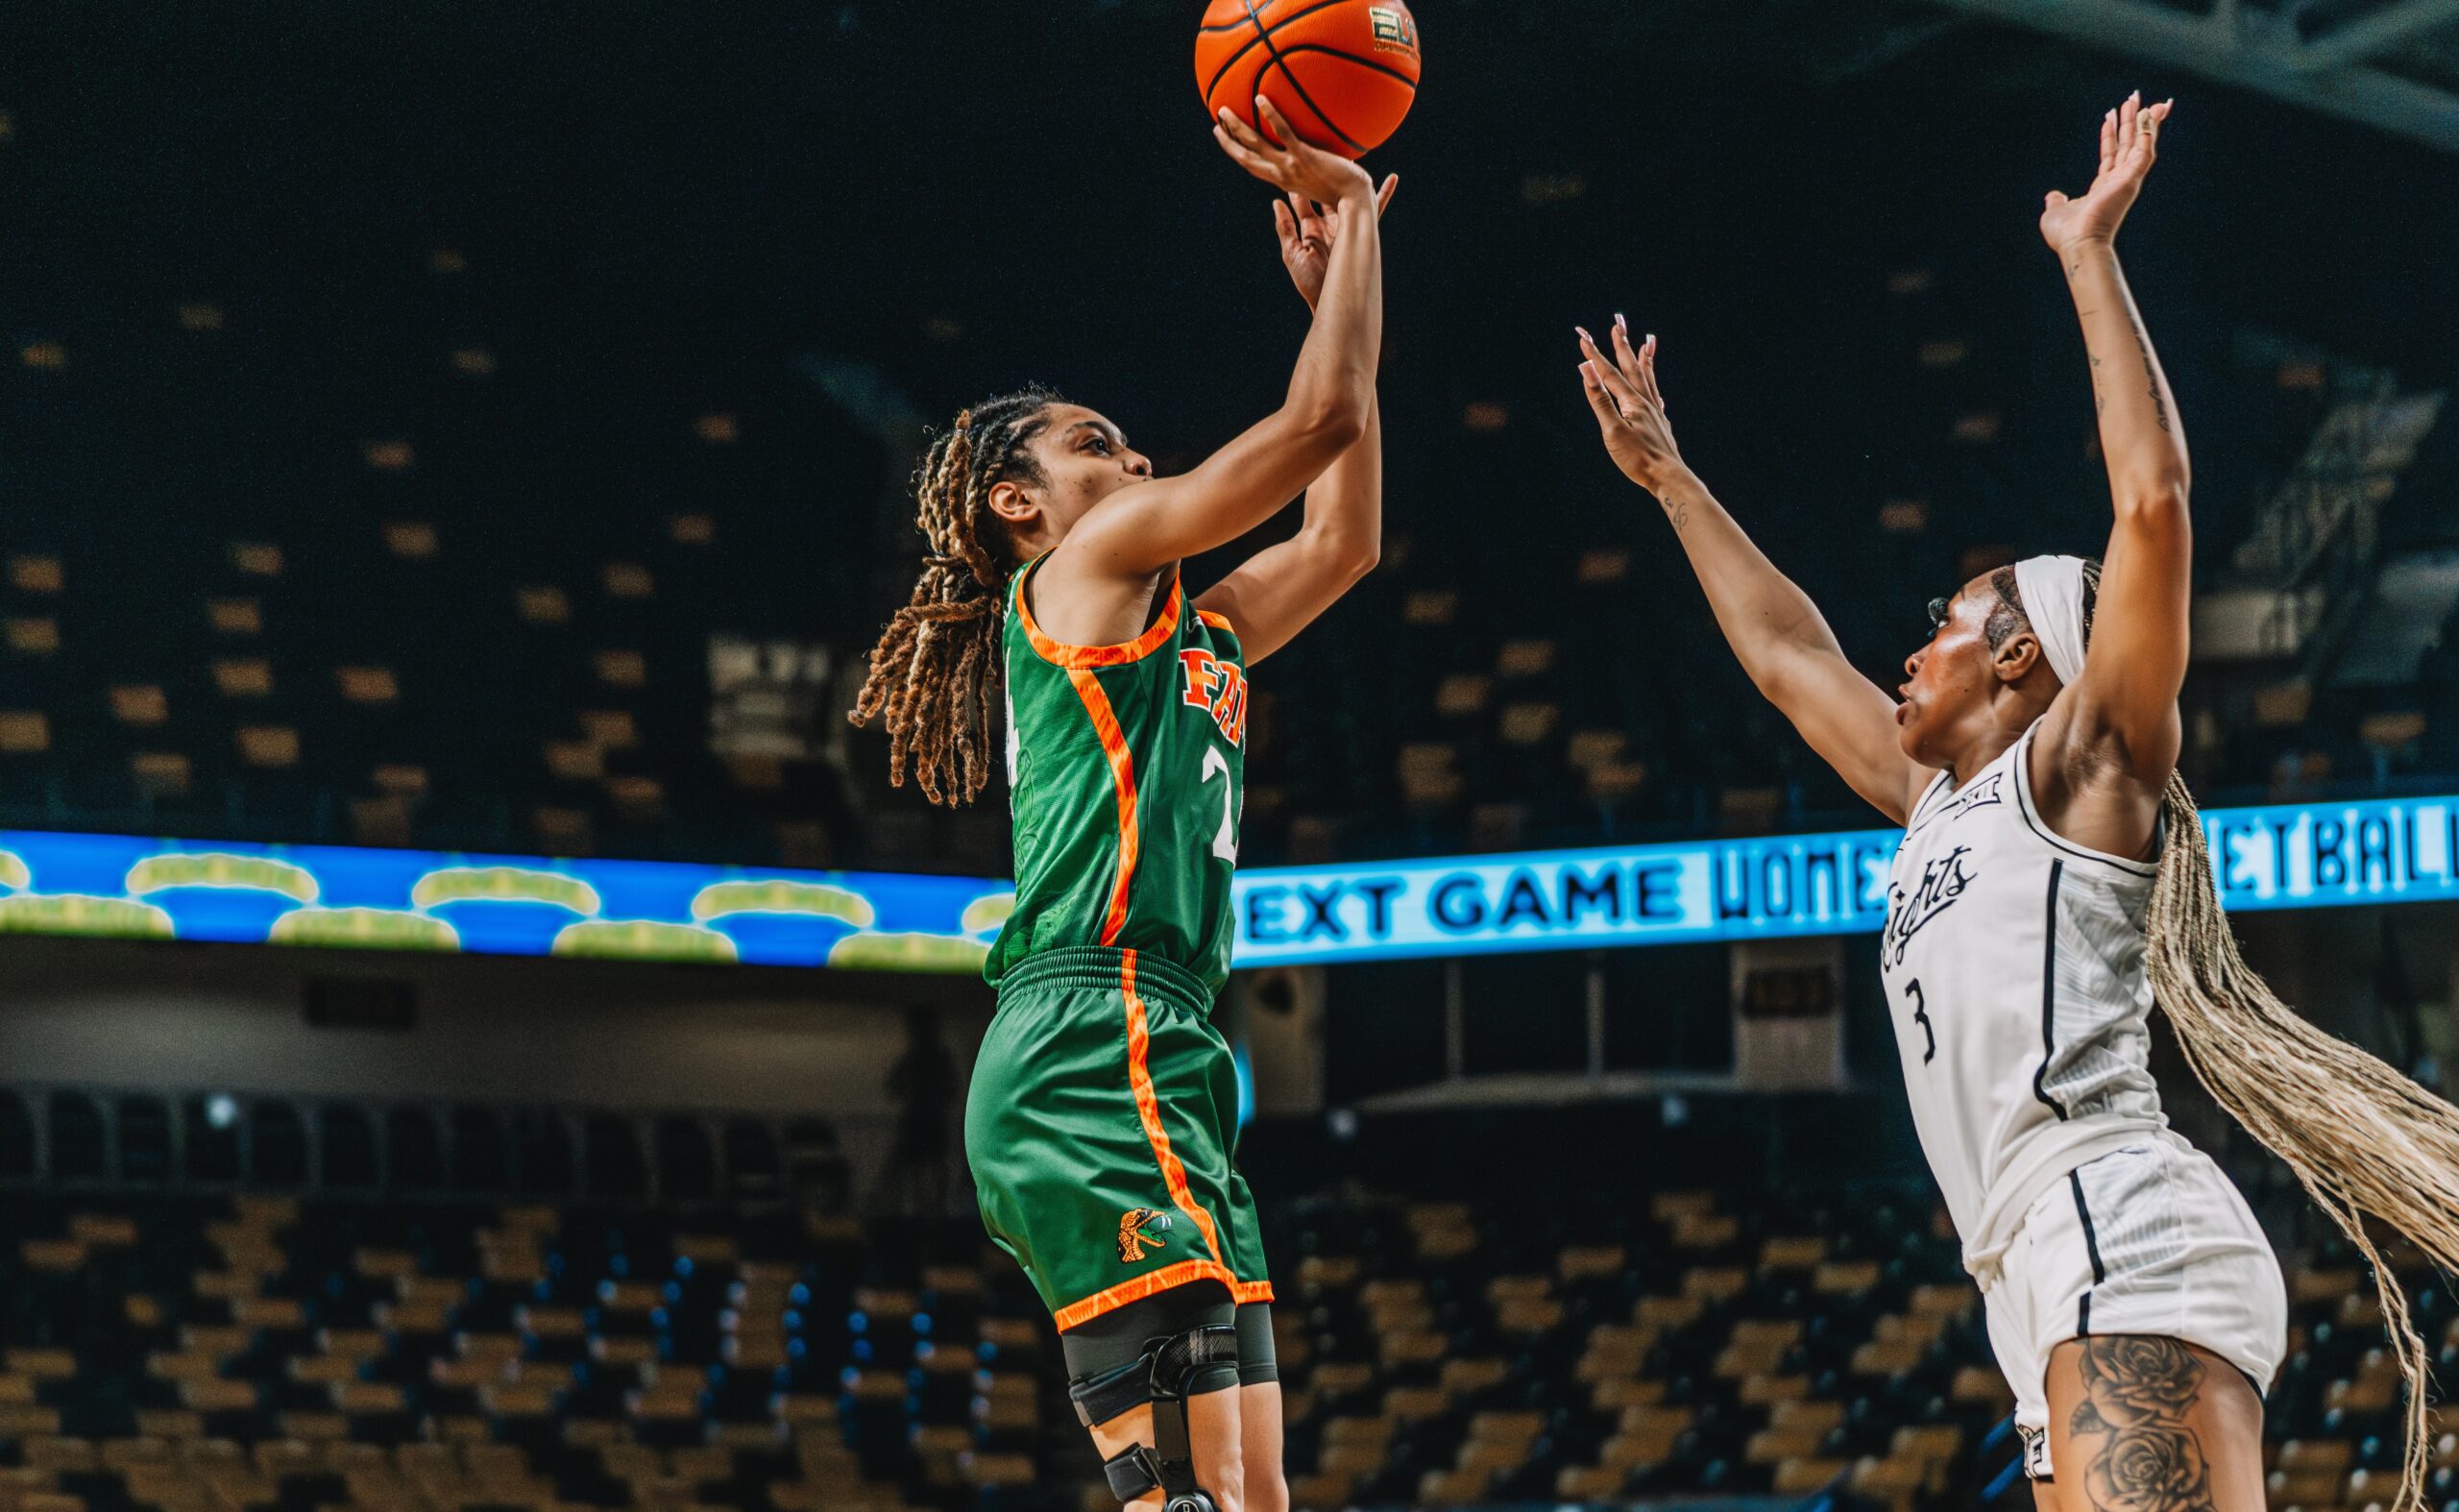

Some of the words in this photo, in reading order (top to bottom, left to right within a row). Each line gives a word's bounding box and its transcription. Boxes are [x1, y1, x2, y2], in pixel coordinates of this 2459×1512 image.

[1248, 877, 1403, 941] EXT
[1430, 860, 1684, 932] GAME
[2221, 813, 2459, 891] ETBAL
[1882, 844, 1979, 974] ights
[1905, 976, 1936, 1068] 3
